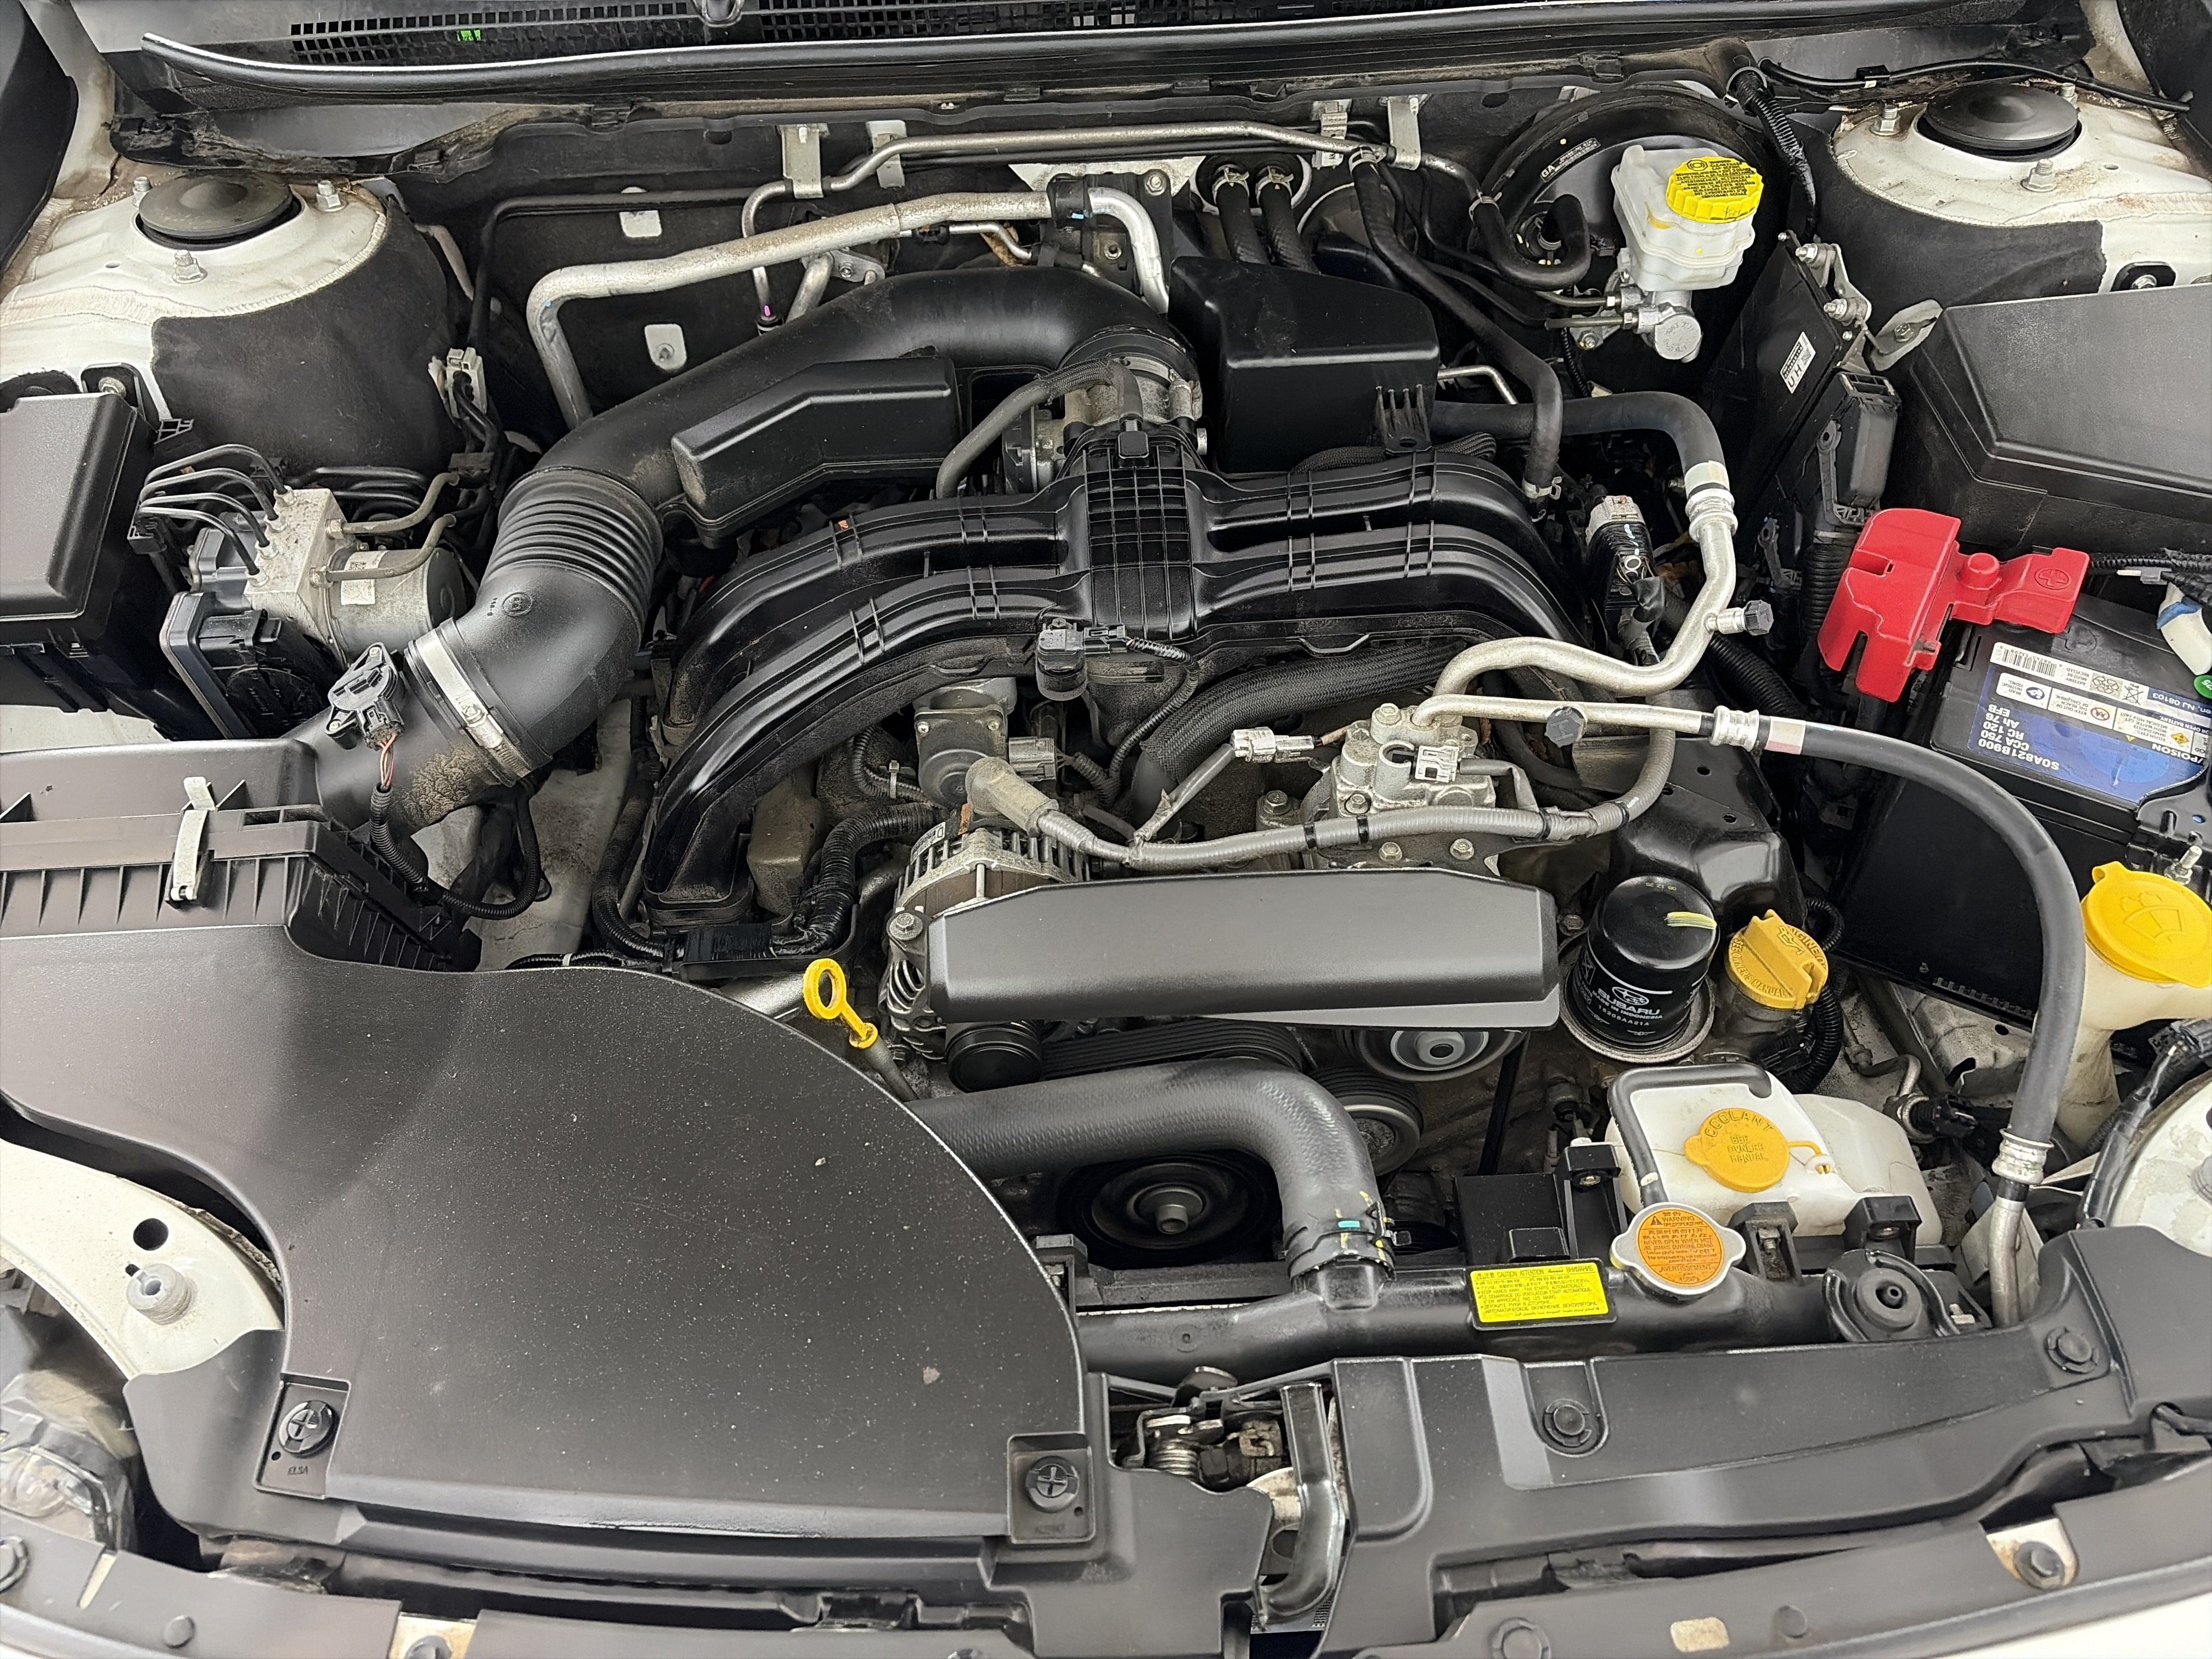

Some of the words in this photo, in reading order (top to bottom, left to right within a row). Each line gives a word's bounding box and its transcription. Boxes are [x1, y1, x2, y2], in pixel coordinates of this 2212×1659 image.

[1542, 165, 1555, 178] GA
[2066, 668, 2089, 678] RECYCLED
[2066, 678, 2086, 686] BATTERY
[2152, 692, 2180, 706] 08103
[1988, 704, 2010, 717] EFB
[2182, 702, 2194, 710] NJ
[1985, 713, 2000, 723] 76
[2003, 718, 2019, 729] Ah
[2159, 715, 2184, 727] BATTERY.
[1983, 721, 2004, 733] 120
[2146, 720, 2168, 729] MEDICAL
[2185, 724, 2200, 732] OPEN
[1981, 730, 2002, 743] 750
[2007, 729, 2024, 740] RC
[2006, 737, 2029, 751] CCA
[1731, 939, 1744, 952] SEE
[1788, 926, 1819, 955] GINE
[1732, 952, 1753, 983] OWNER'S
[1751, 979, 1787, 997] MANUAL
[1592, 990, 1610, 1007] MADE
[1621, 1009, 1663, 1019] INDONESIA
[1598, 988, 1660, 1015] SUBARU
[1705, 1111, 1774, 1137] COOLANT
[1730, 1135, 1749, 1144] SEE
[1730, 1153, 1766, 1163] MANUAL
